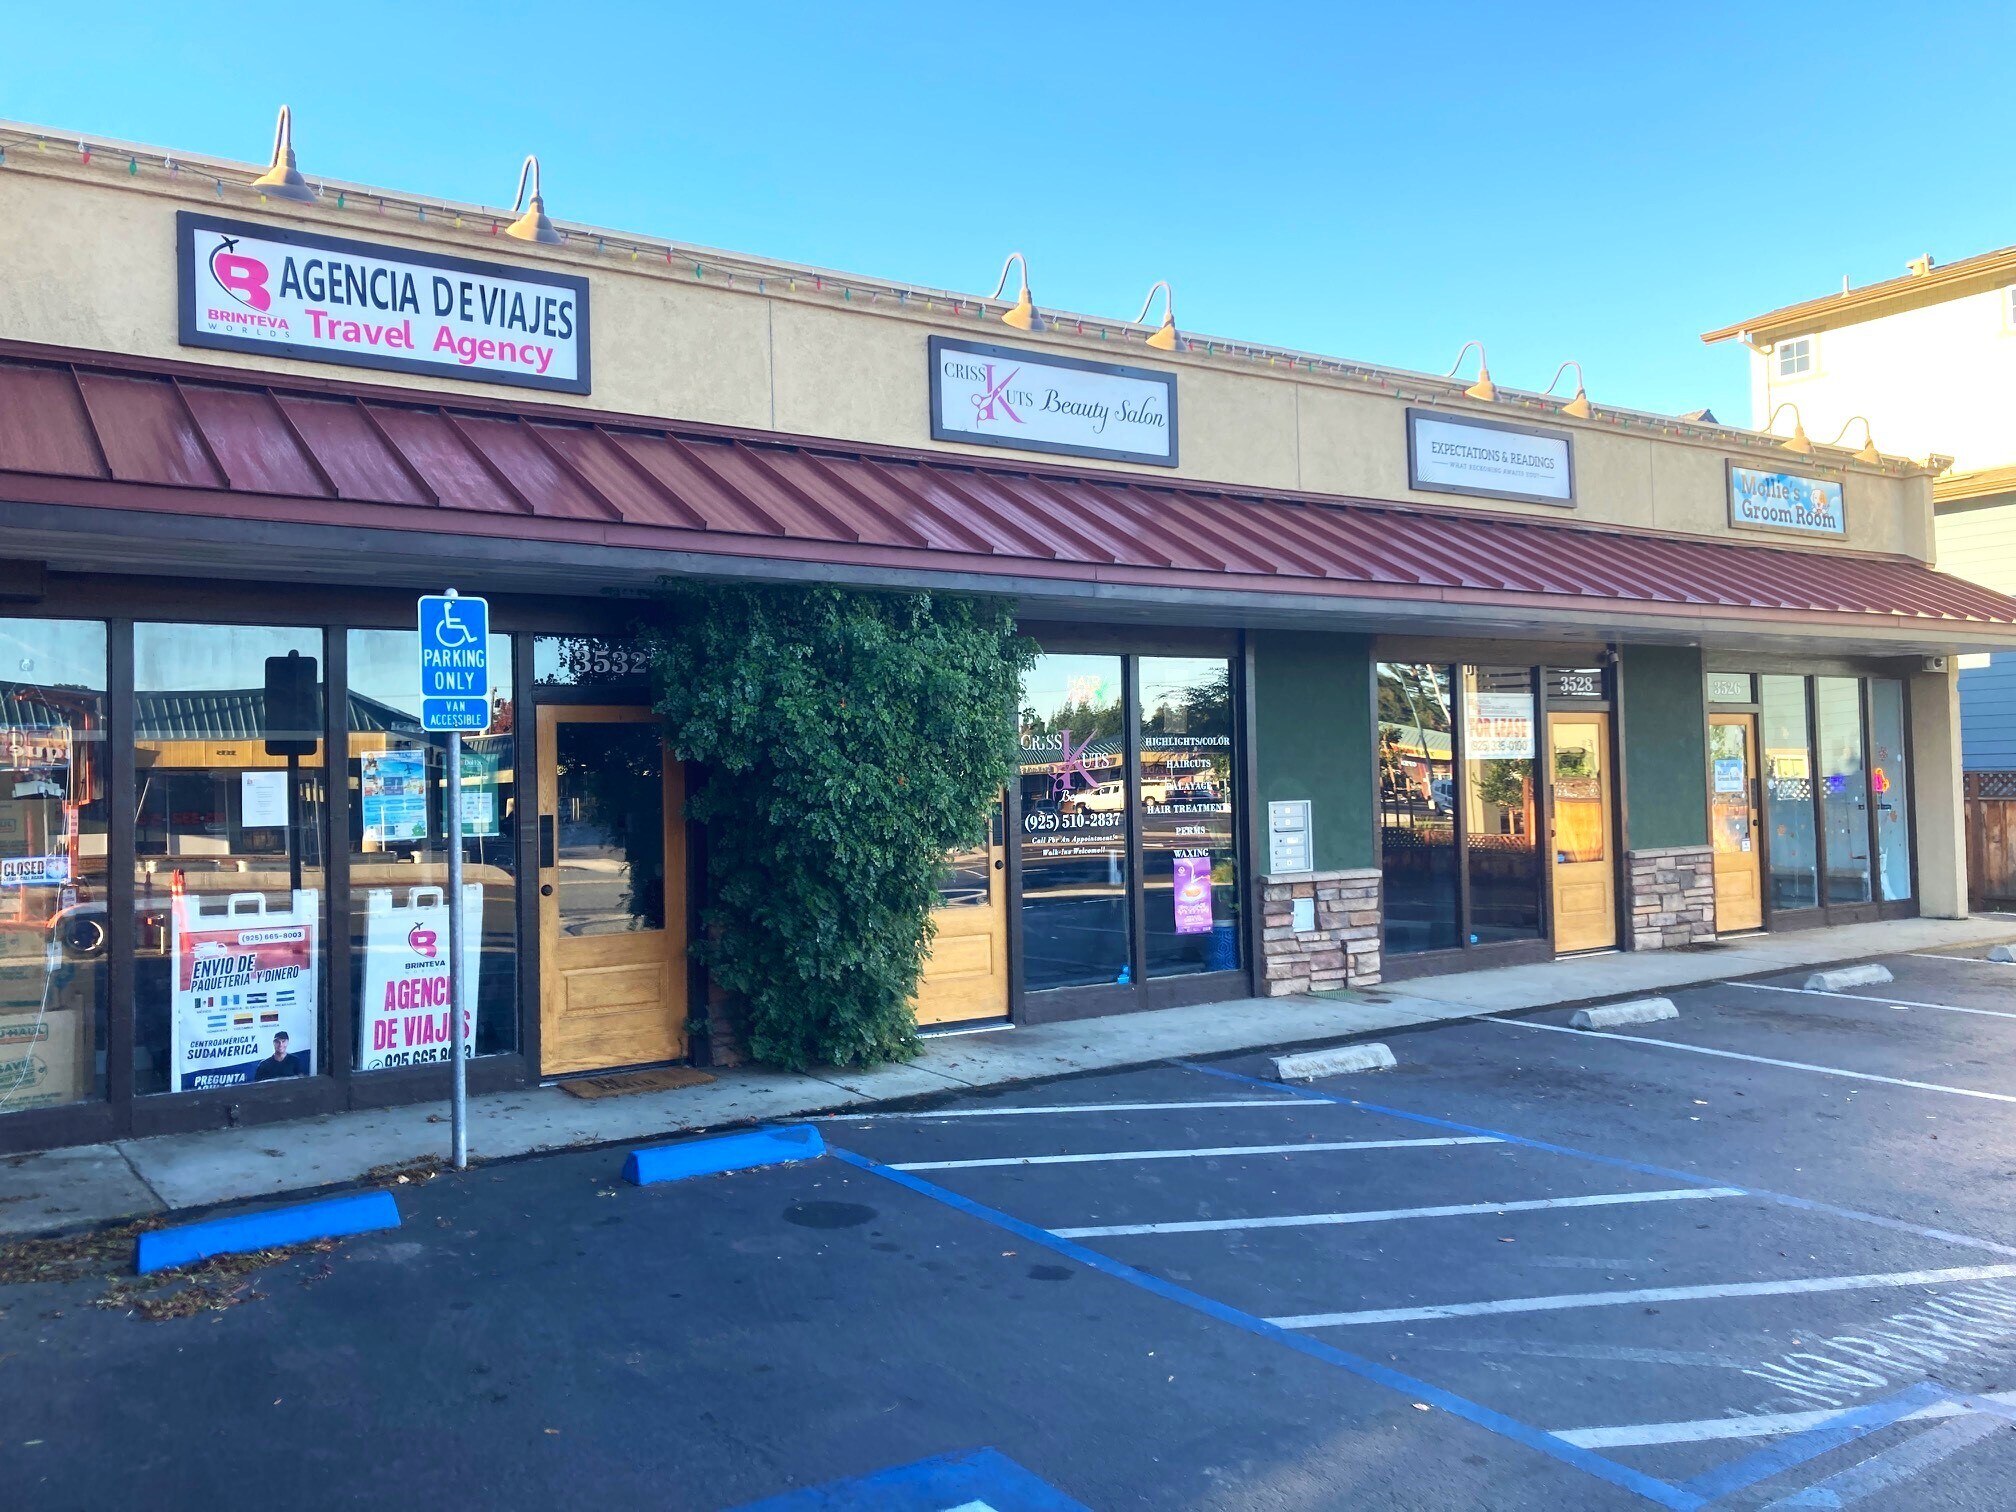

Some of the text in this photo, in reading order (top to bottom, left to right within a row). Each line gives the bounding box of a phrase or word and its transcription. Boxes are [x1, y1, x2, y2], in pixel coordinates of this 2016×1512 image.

[279, 256, 573, 340] AGENCIA DE VIAJES
[208, 309, 289, 330] BRINTEVA
[208, 322, 290, 338] WORLDS
[305, 309, 554, 374] Travel Agency
[944, 361, 987, 382] CRISS
[1039, 388, 1109, 434] Beauty
[1114, 396, 1166, 428] Salon
[1431, 441, 1500, 462] EXPECTATIONS
[1501, 451, 1508, 463] &
[1741, 474, 1801, 501] Mollie's
[1741, 499, 1836, 529] Groom Room
[424, 649, 485, 669] PARKING
[573, 650, 647, 674] 3532
[434, 672, 475, 690] ONLY
[1560, 676, 1593, 691] 3528
[1714, 681, 1741, 695] 3526
[445, 700, 466, 712] VAN
[430, 713, 482, 727] ACCESSIBLE
[1469, 717, 1527, 738] FOR LEASE
[1145, 736, 1230, 747] HIGHLIGHTS/COLOR
[1167, 759, 1211, 769] HAIRCUTS
[1147, 805, 1171, 815] HAIR
[1024, 812, 1121, 833] (925) 510-2837
[1175, 826, 1206, 837] PERMS
[1032, 836, 1046, 845] Call
[1048, 836, 1060, 844] For
[1173, 848, 1209, 859] WAXING
[4, 860, 45, 877] CLOSED
[241, 931, 302, 943] (925) 665-8003
[193, 953, 256, 980] ENVIO DE
[404, 960, 446, 970] BRINTEVA
[190, 965, 300, 993] PAQUETERIA Y DINERO
[383, 975, 451, 1012] AGENCI
[373, 1009, 471, 1050] DE VIAJS
[190, 1034, 256, 1048] CENTROAMÉRICA Y
[187, 1043, 259, 1060] SUDAMERICA
[194, 1073, 246, 1087] PREGUNTA
